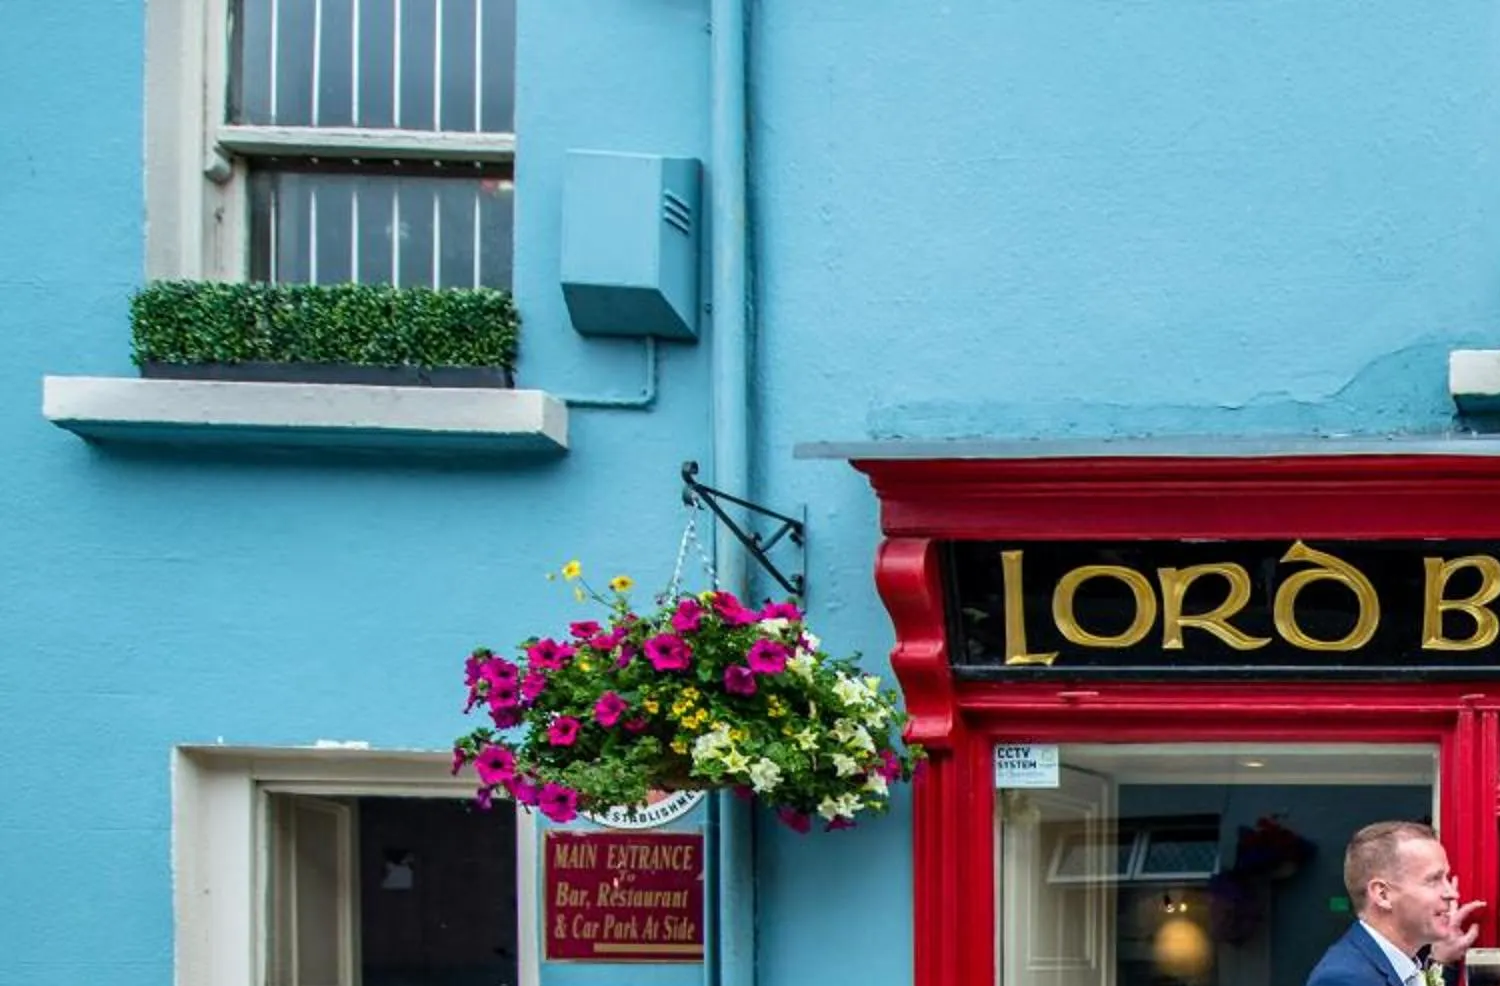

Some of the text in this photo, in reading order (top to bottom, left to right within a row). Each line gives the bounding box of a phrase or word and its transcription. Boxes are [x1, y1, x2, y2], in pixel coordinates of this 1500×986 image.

[1000, 540, 1380, 666] Lord
[998, 747, 1031, 758] CCTV
[998, 760, 1037, 769] SYSTEM
[554, 843, 694, 870] MAIN ENTRANCE
[619, 871, 635, 882] To
[555, 882, 688, 909] Bar, Restaurant
[554, 914, 696, 941] & Car Park At Side
